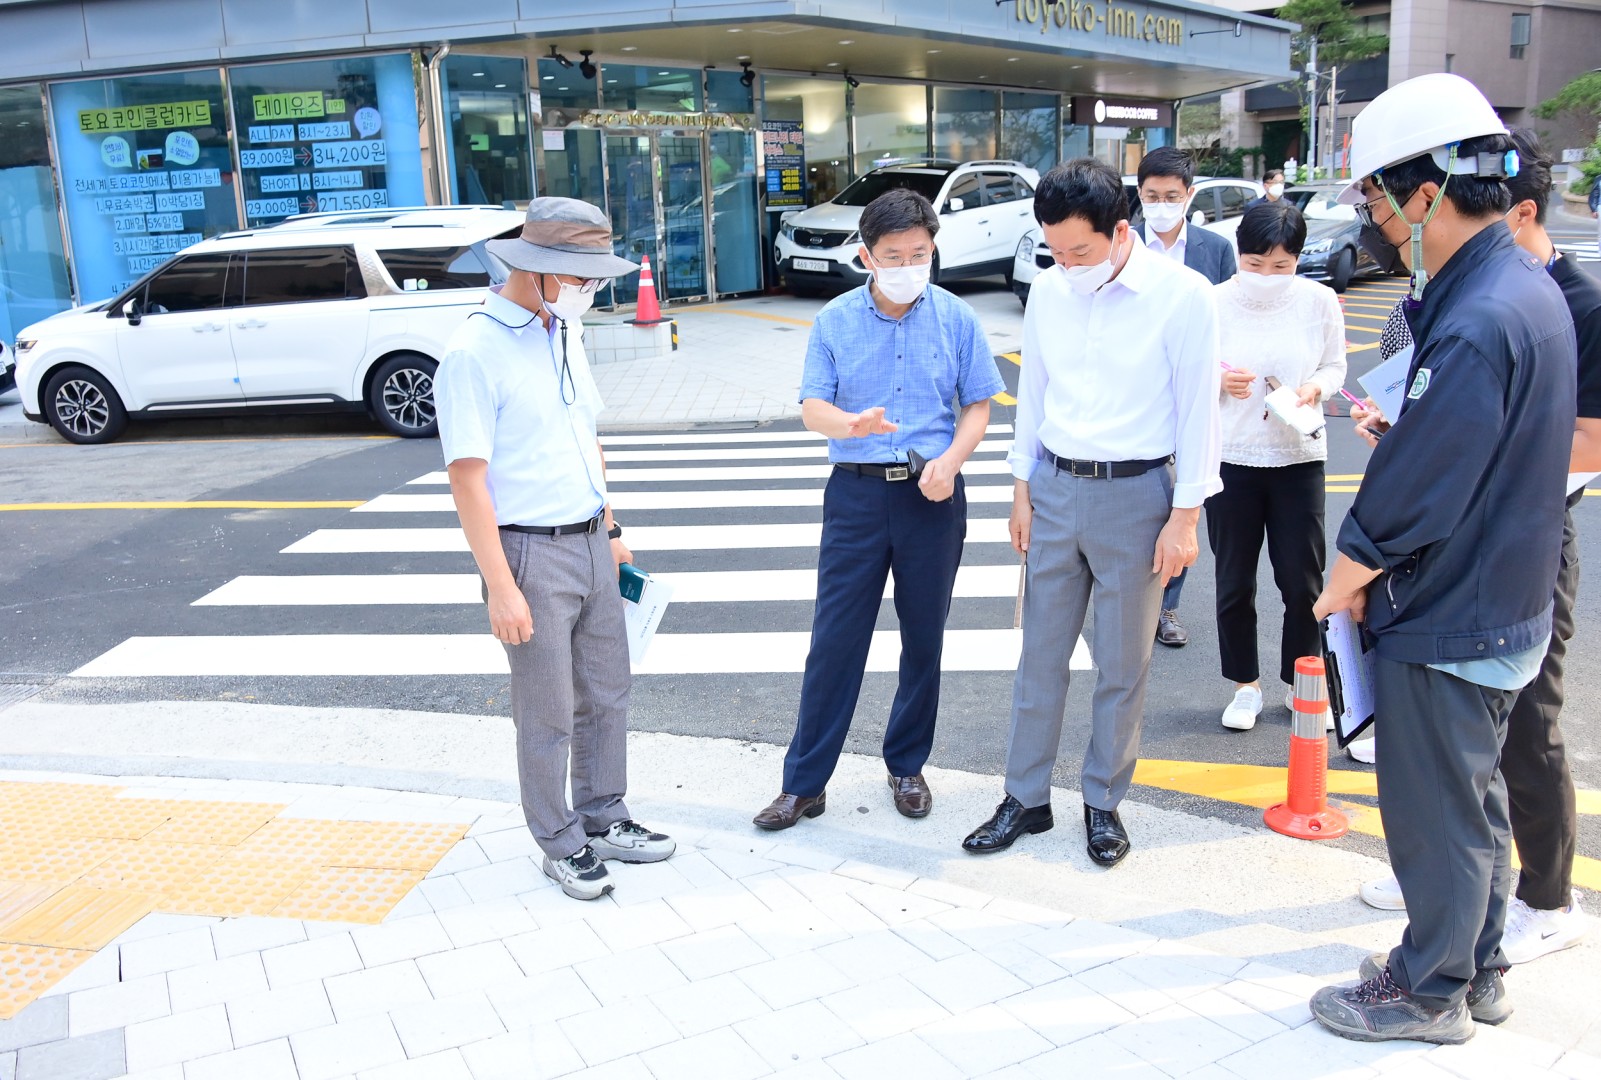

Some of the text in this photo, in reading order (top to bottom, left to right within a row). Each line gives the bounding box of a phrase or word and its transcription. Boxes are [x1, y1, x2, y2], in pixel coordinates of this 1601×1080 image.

[255, 96, 322, 117] 데이유즈
[80, 104, 210, 131] 토요코인클럽카드
[250, 129, 270, 141] ALL
[271, 128, 293, 140] DAY
[242, 149, 293, 165] 39,000원
[314, 142, 386, 164] 34,200원
[75, 171, 220, 192] 전세계 토요코인에서 이용가능!!
[262, 176, 297, 190] SHORT
[302, 178, 309, 188] A
[248, 198, 297, 214] 29,000원
